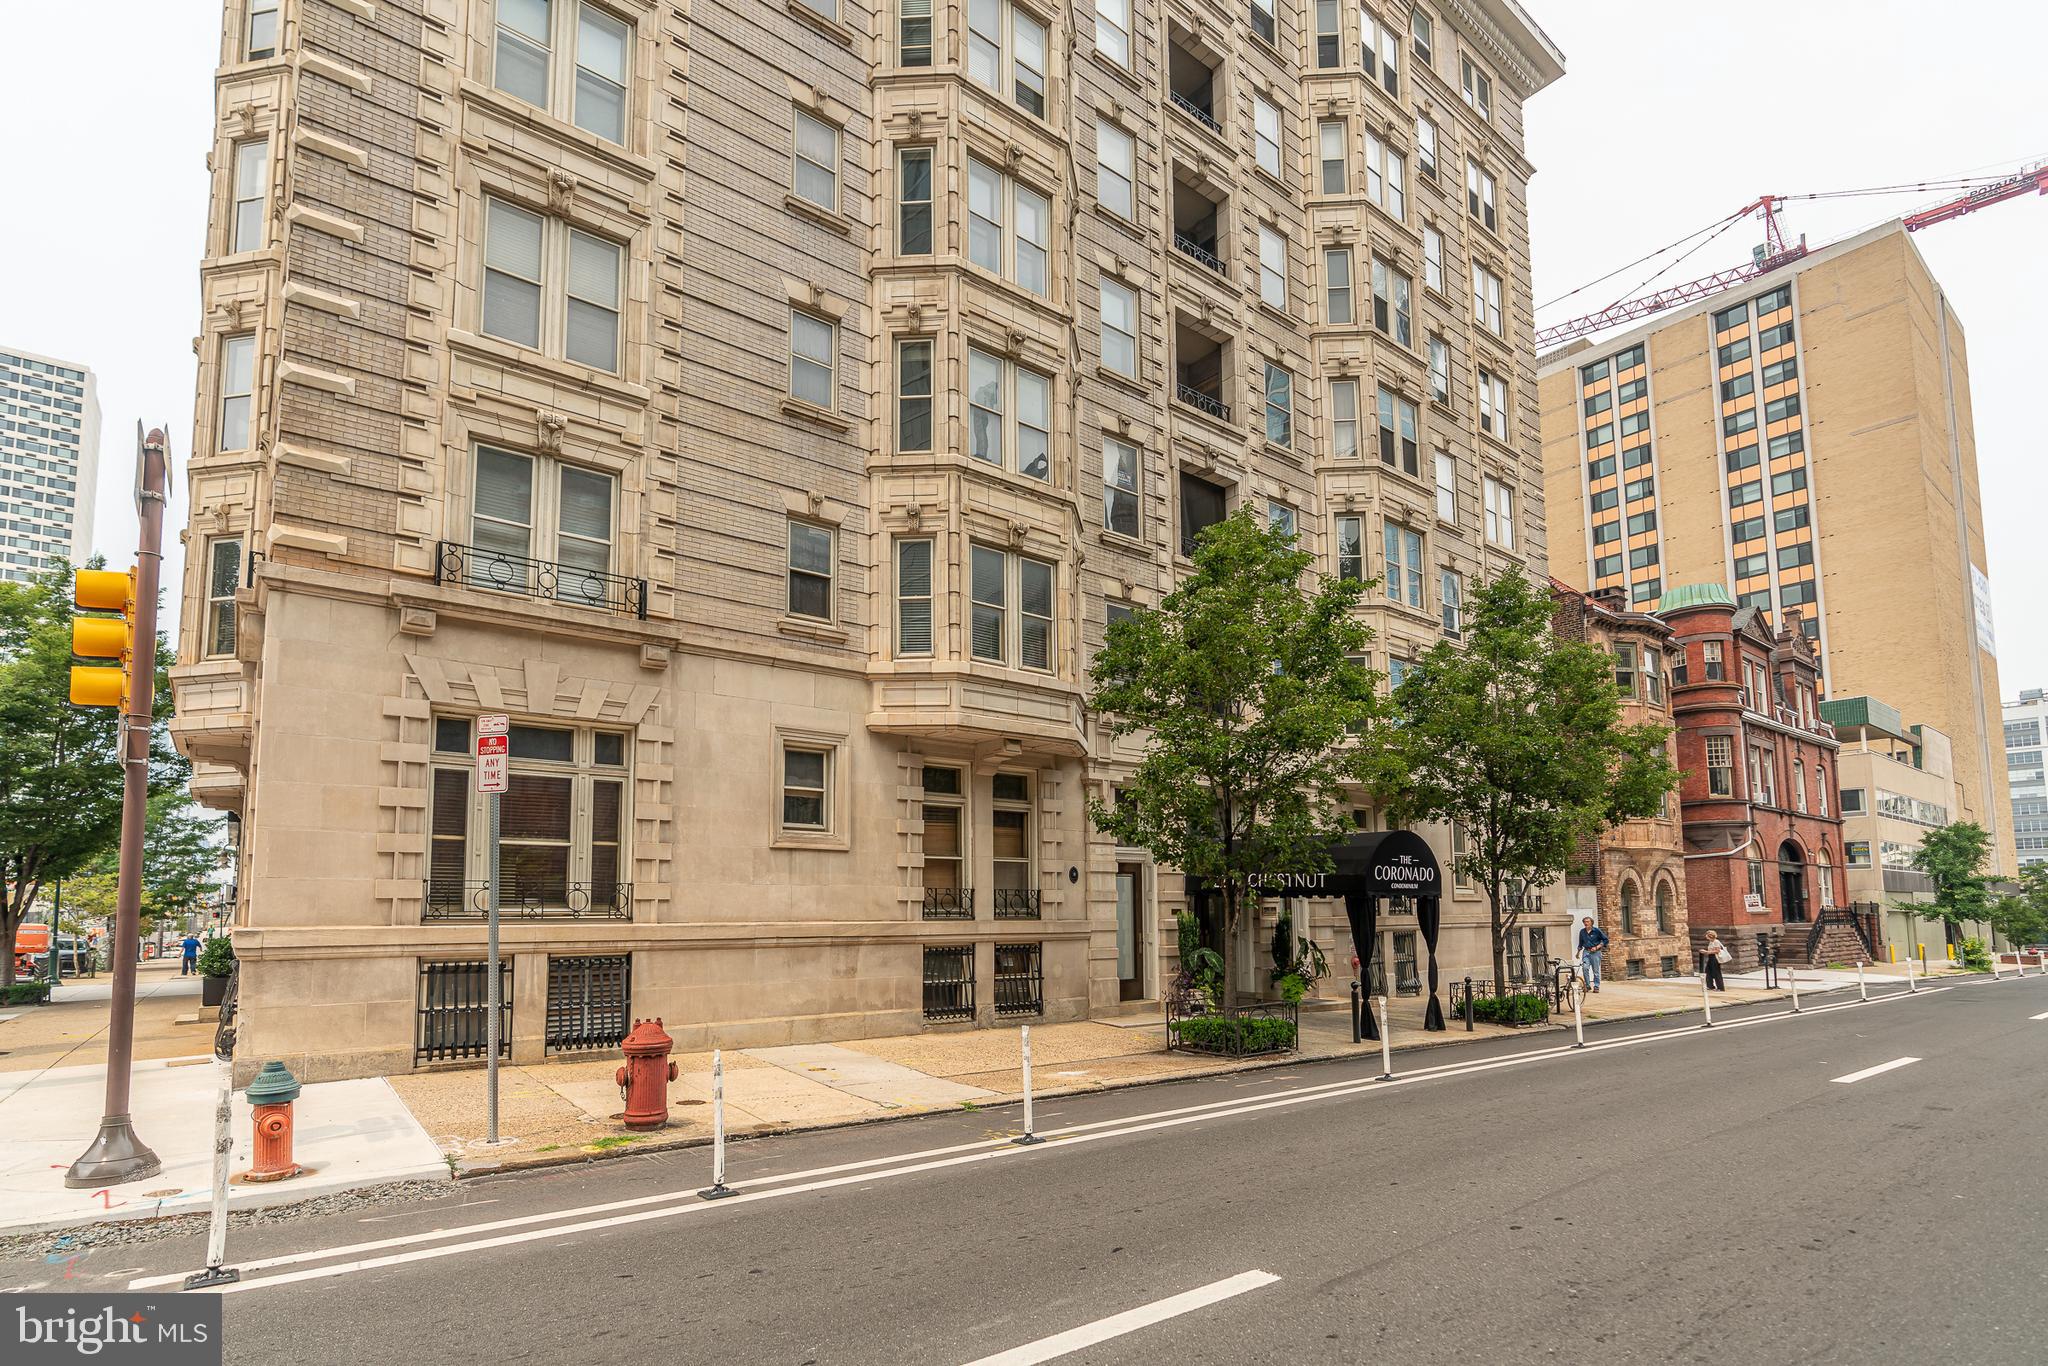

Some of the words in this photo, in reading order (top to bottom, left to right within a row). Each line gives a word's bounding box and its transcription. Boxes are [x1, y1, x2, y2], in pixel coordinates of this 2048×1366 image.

[1969, 176, 2018, 197] POTAIN
[488, 738, 498, 746] NO
[480, 745, 506, 755] STOPPING
[485, 758, 500, 768] ANY
[484, 770, 502, 780] TIME
[1399, 855, 1413, 865] THE
[1374, 865, 1434, 882] CORONADO
[1247, 873, 1327, 888] CHSTNUT
